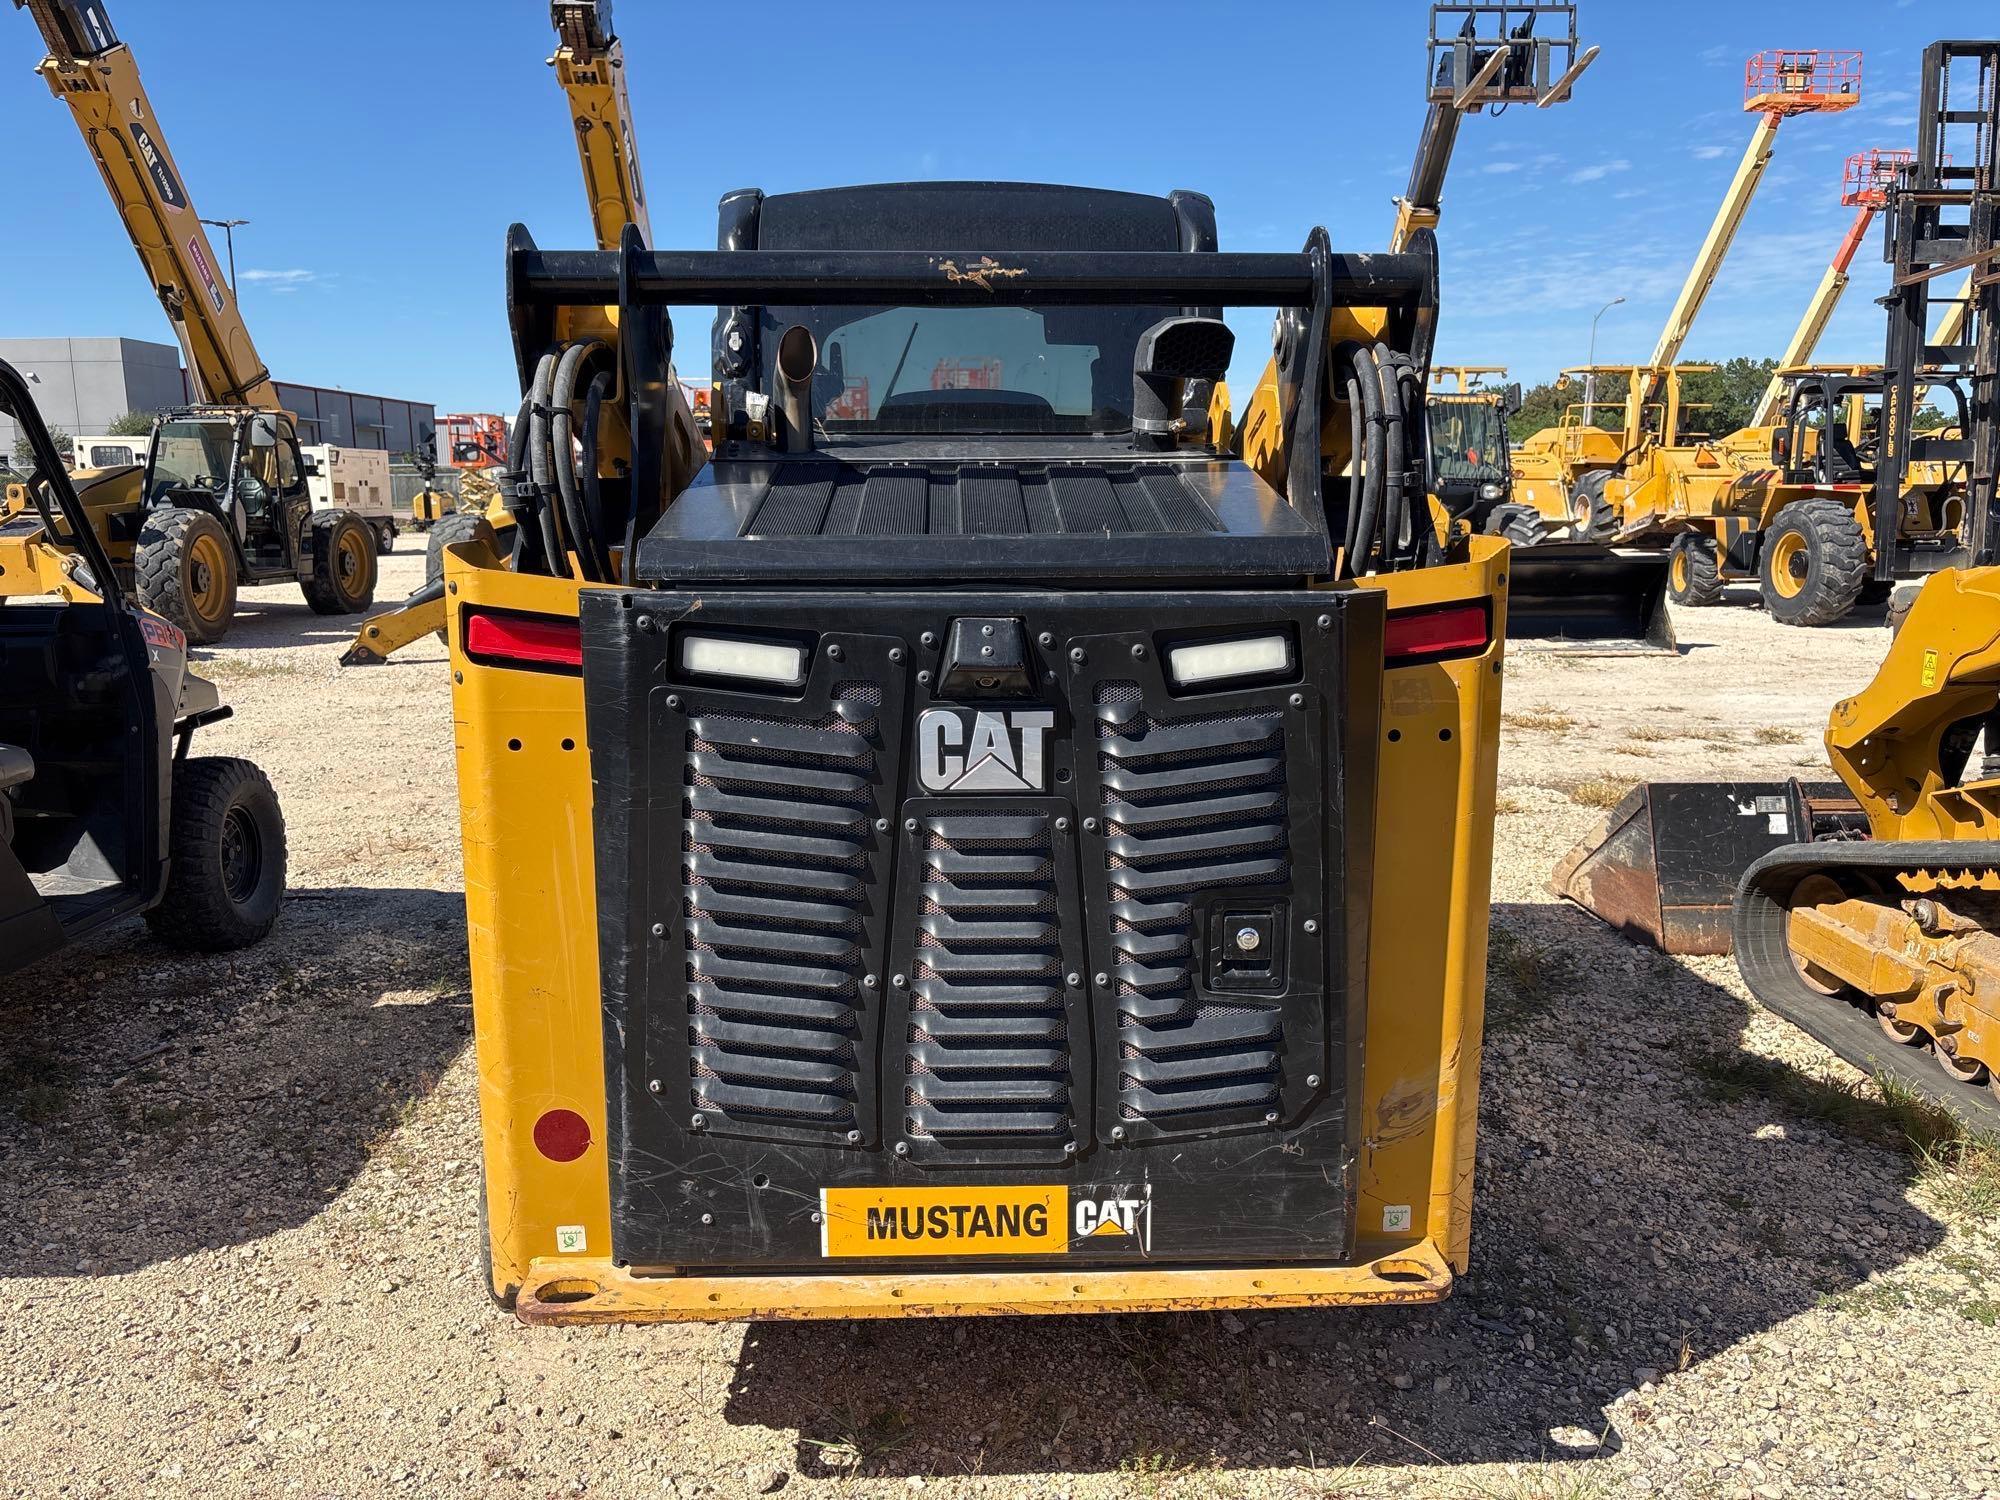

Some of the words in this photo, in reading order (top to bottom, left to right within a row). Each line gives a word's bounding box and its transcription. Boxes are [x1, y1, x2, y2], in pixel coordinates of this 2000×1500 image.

[138, 133, 158, 168] CAT
[191, 244, 210, 281] MUSTANG
[919, 710, 1054, 791] CAT
[867, 1203, 1048, 1240] MUSTANG
[1076, 1199, 1139, 1237] CAT
